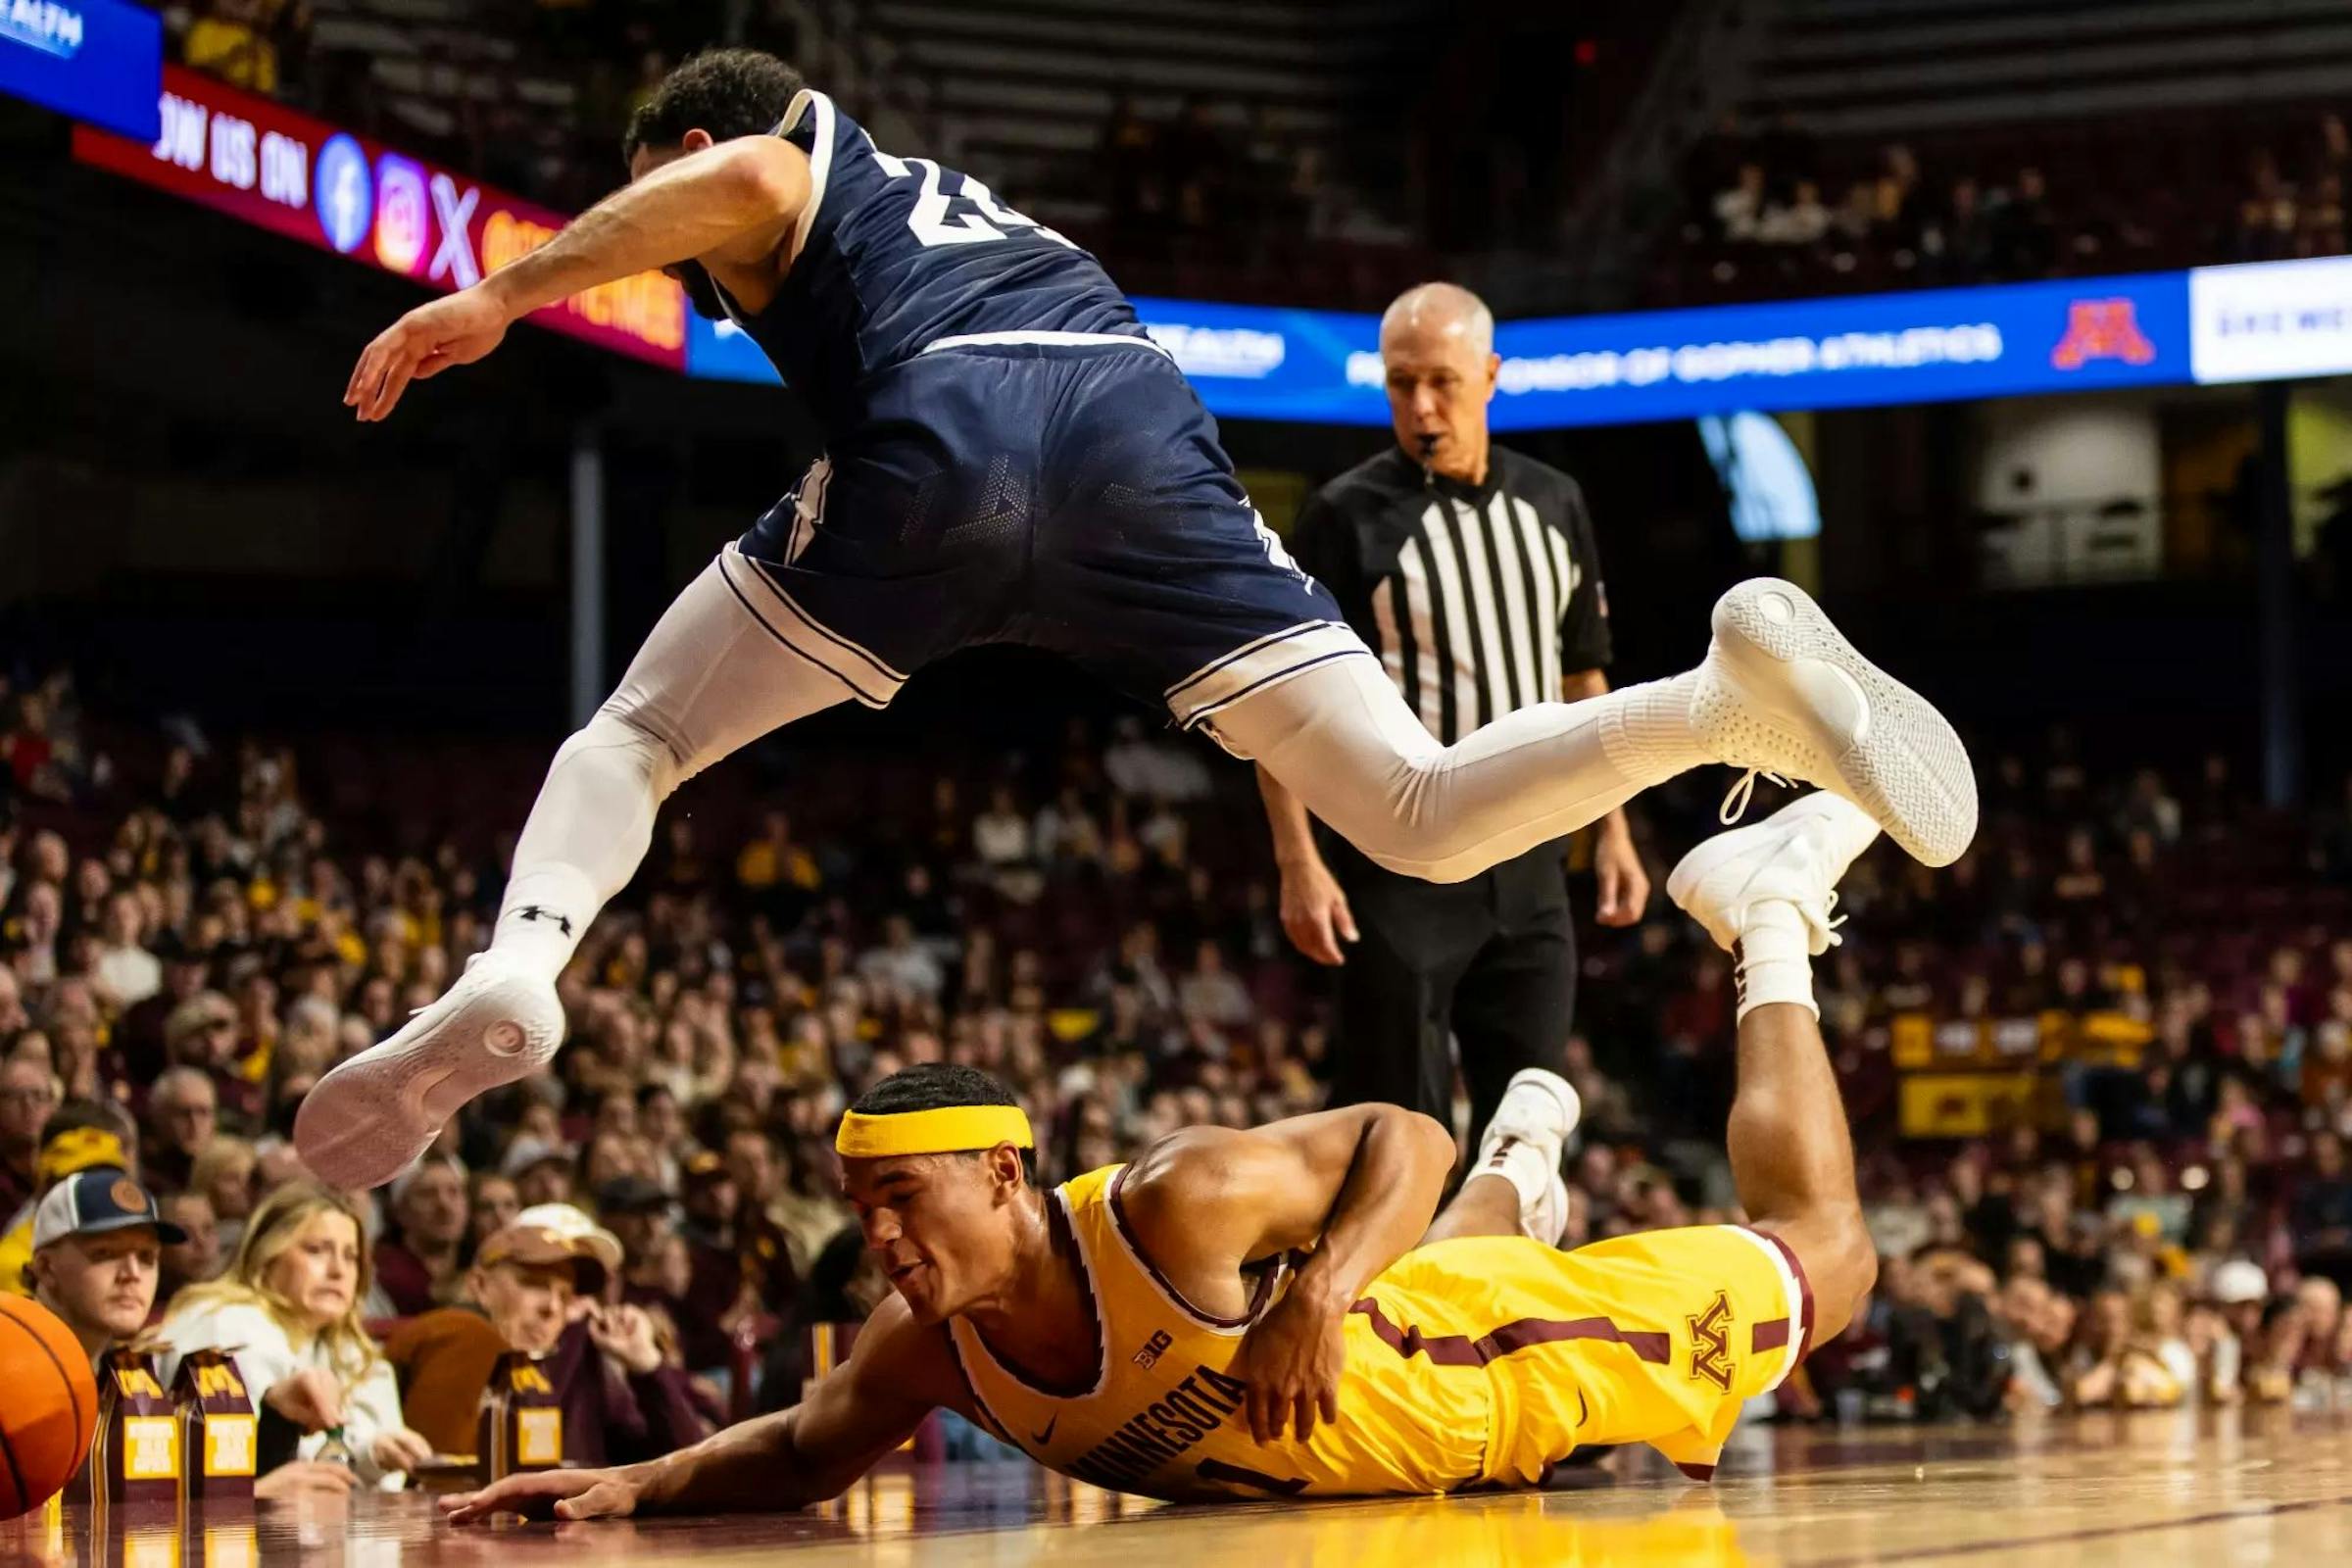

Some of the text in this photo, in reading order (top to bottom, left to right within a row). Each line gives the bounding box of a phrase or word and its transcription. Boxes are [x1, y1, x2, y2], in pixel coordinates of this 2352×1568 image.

[0, 0, 83, 46] ALTH
[211, 111, 256, 190] US
[260, 130, 308, 210] ON
[1686, 1290, 1736, 1395] M
[1064, 1364, 1248, 1489] MINNESOTA
